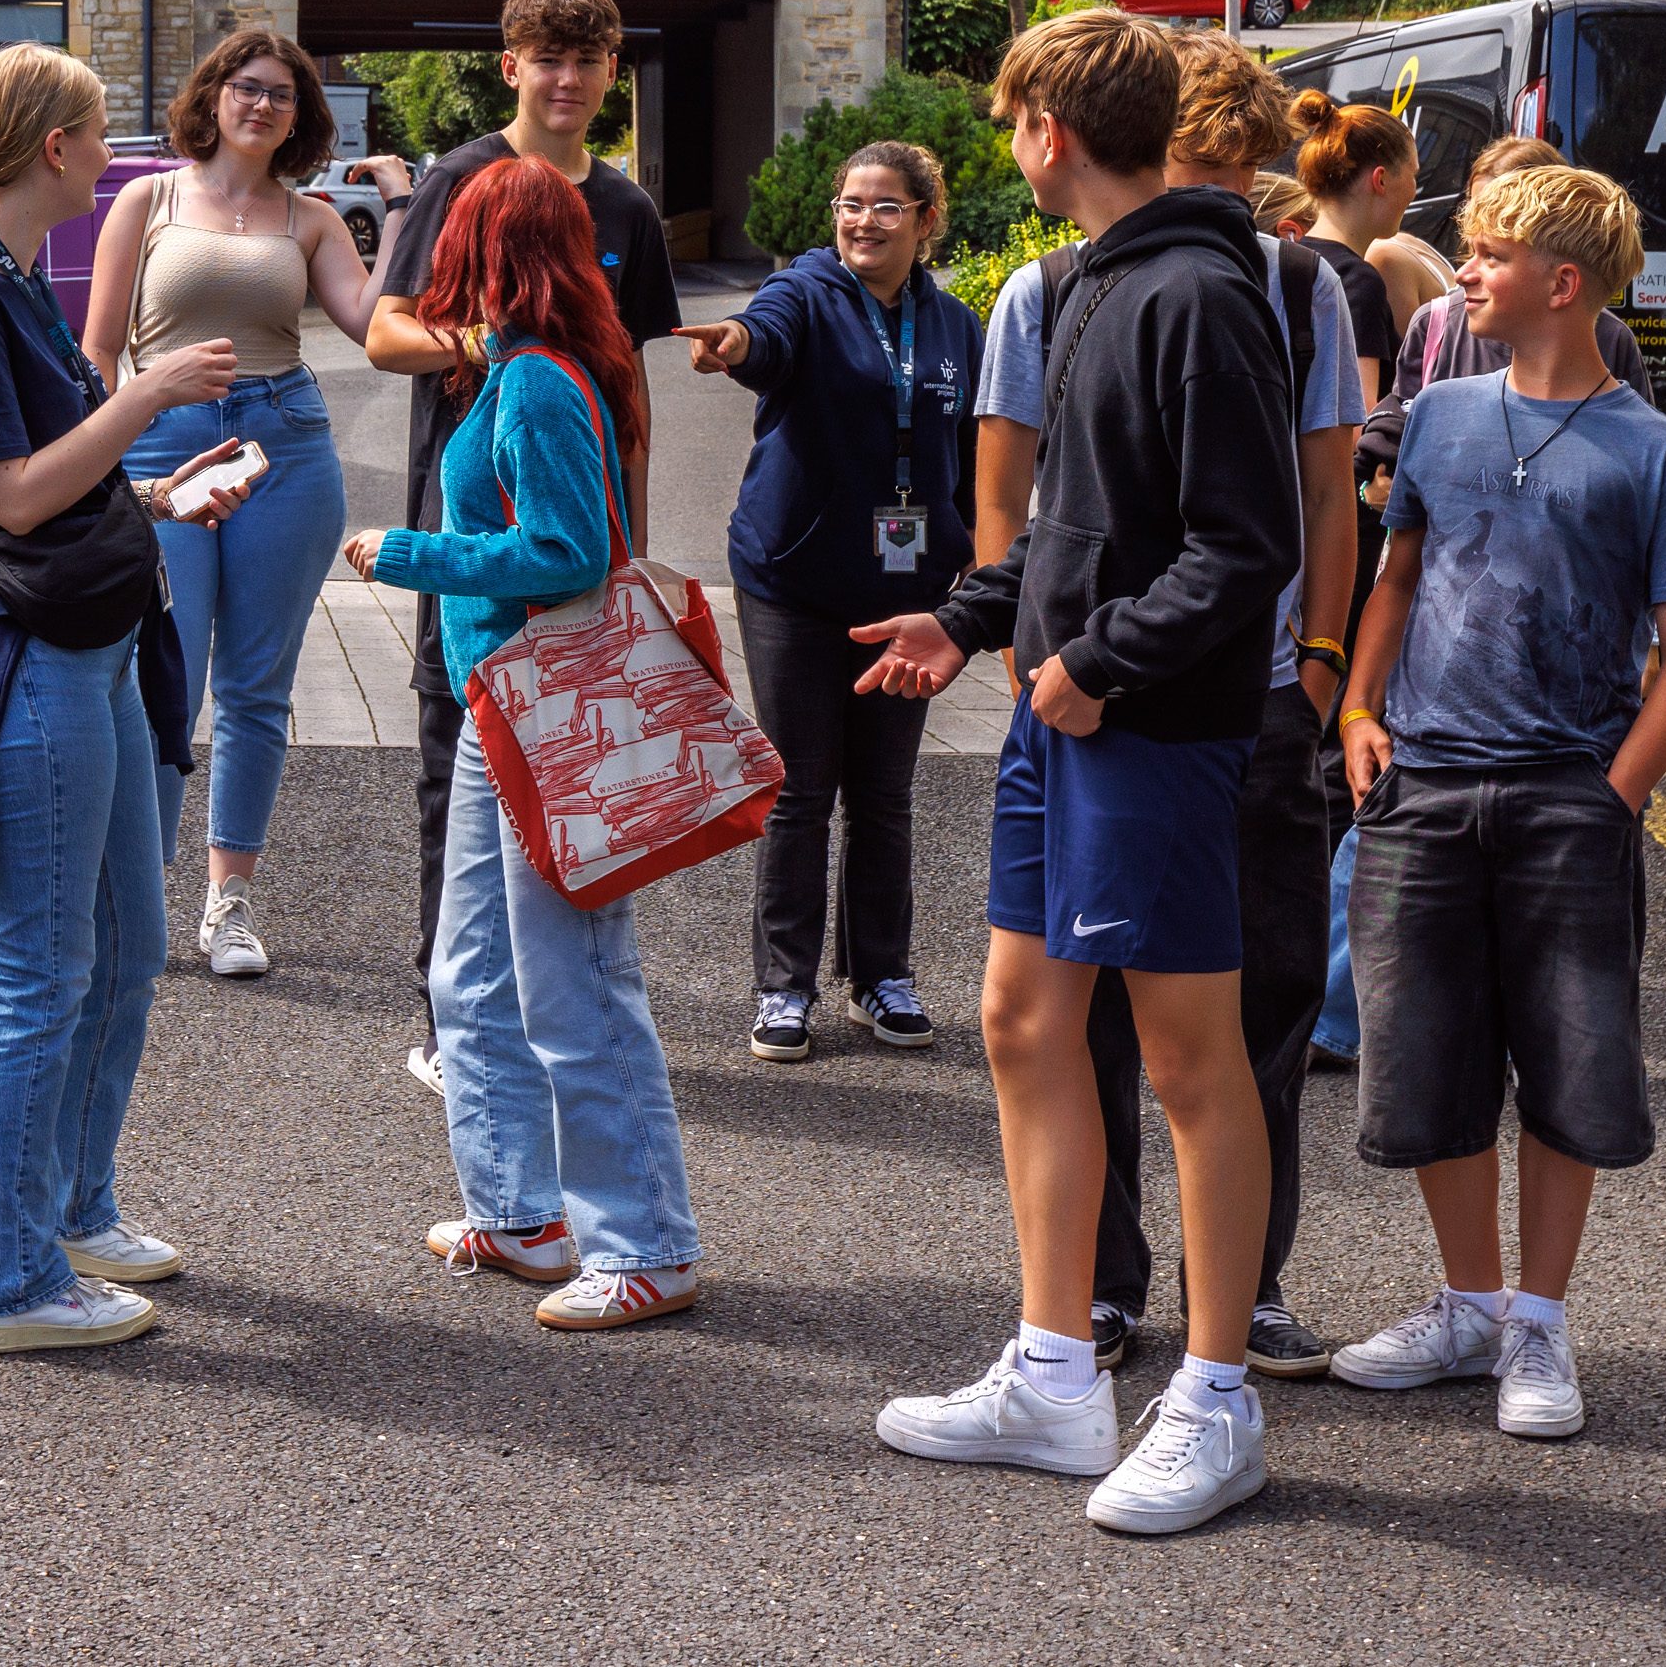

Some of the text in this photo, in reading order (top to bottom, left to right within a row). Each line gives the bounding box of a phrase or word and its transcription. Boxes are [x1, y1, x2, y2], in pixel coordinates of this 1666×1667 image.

[1467, 466, 1577, 508] ASTURIAS
[530, 616, 599, 635] WATERSTONES
[597, 770, 669, 794] WATERSTONES
